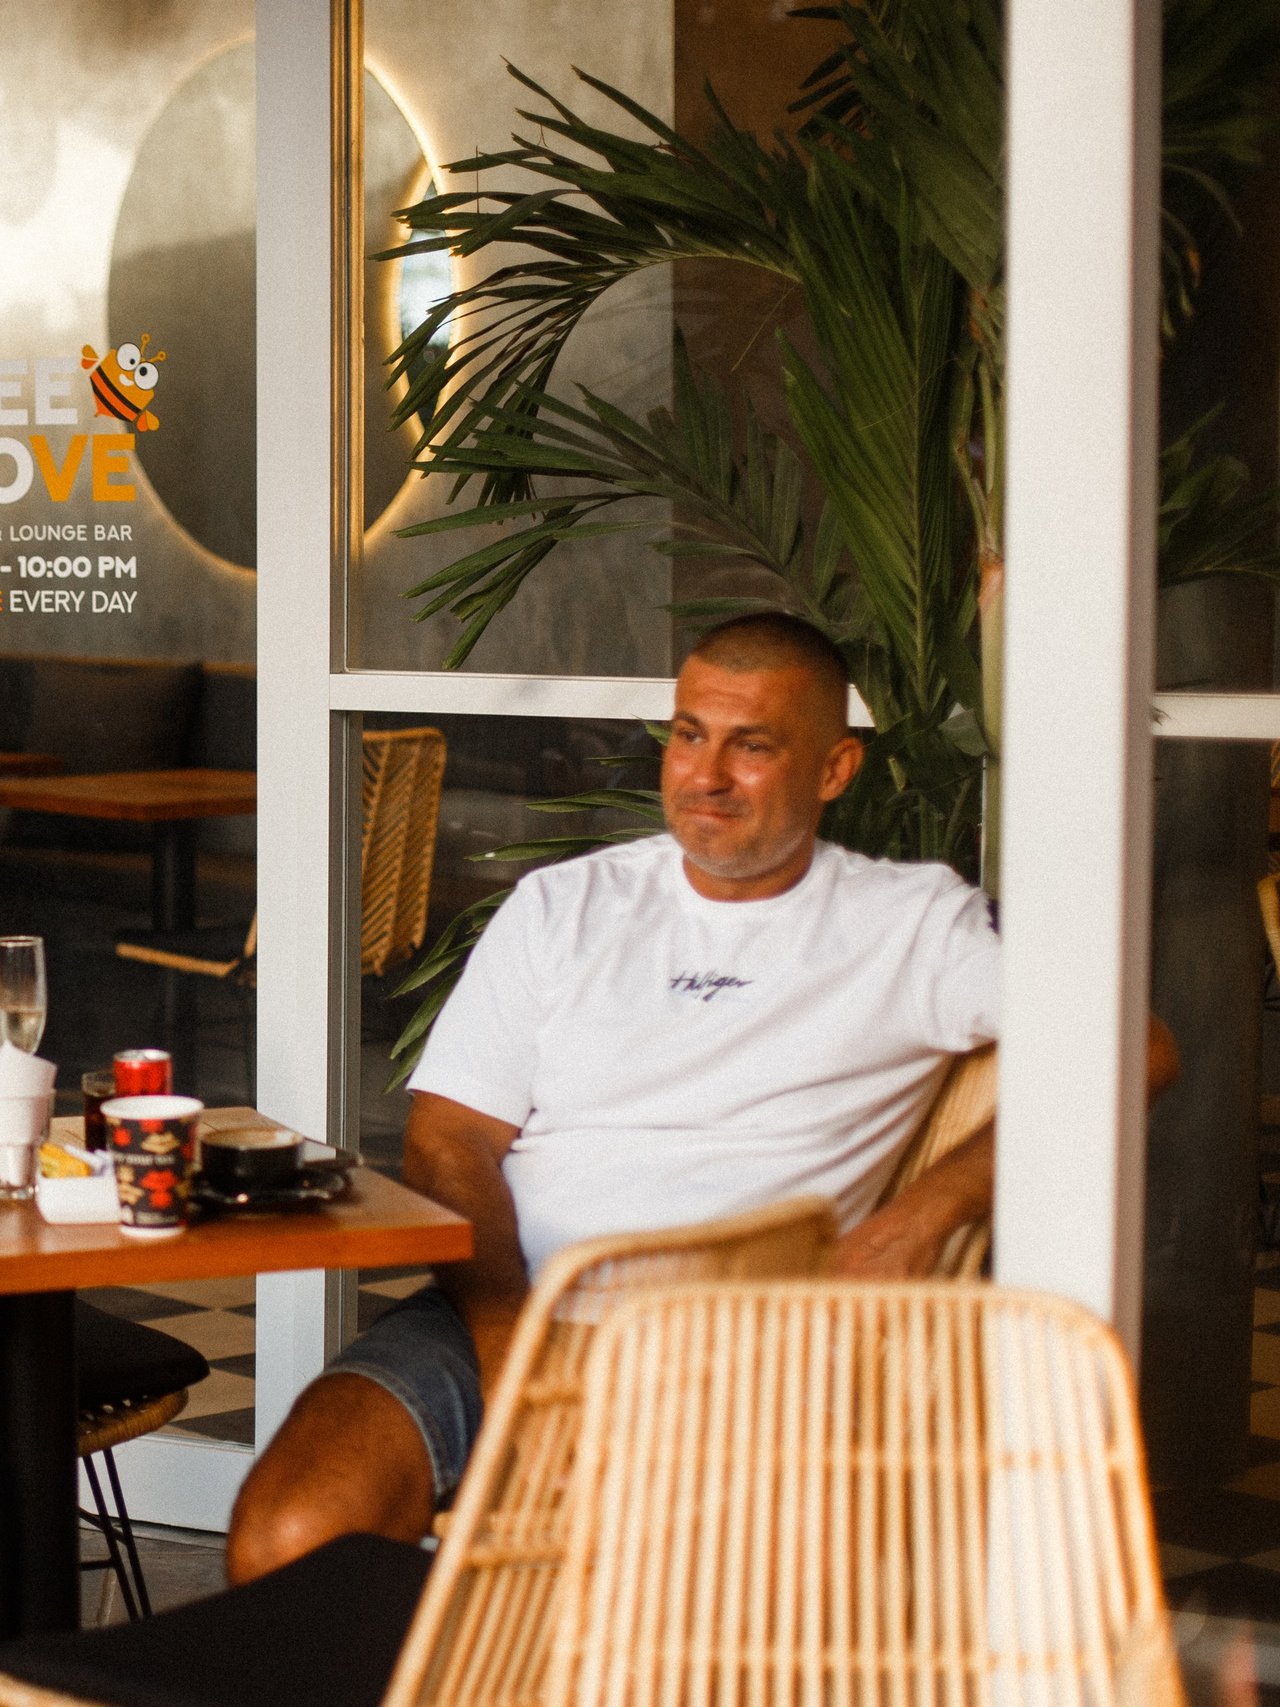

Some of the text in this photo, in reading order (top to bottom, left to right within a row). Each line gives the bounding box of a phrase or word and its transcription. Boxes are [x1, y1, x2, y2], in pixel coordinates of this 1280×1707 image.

[9, 524, 87, 542] LOUNGE
[93, 524, 133, 542] BAR
[17, 555, 92, 578] 10:00
[97, 556, 137, 578] PM
[9, 590, 137, 613] EVERY DAY
